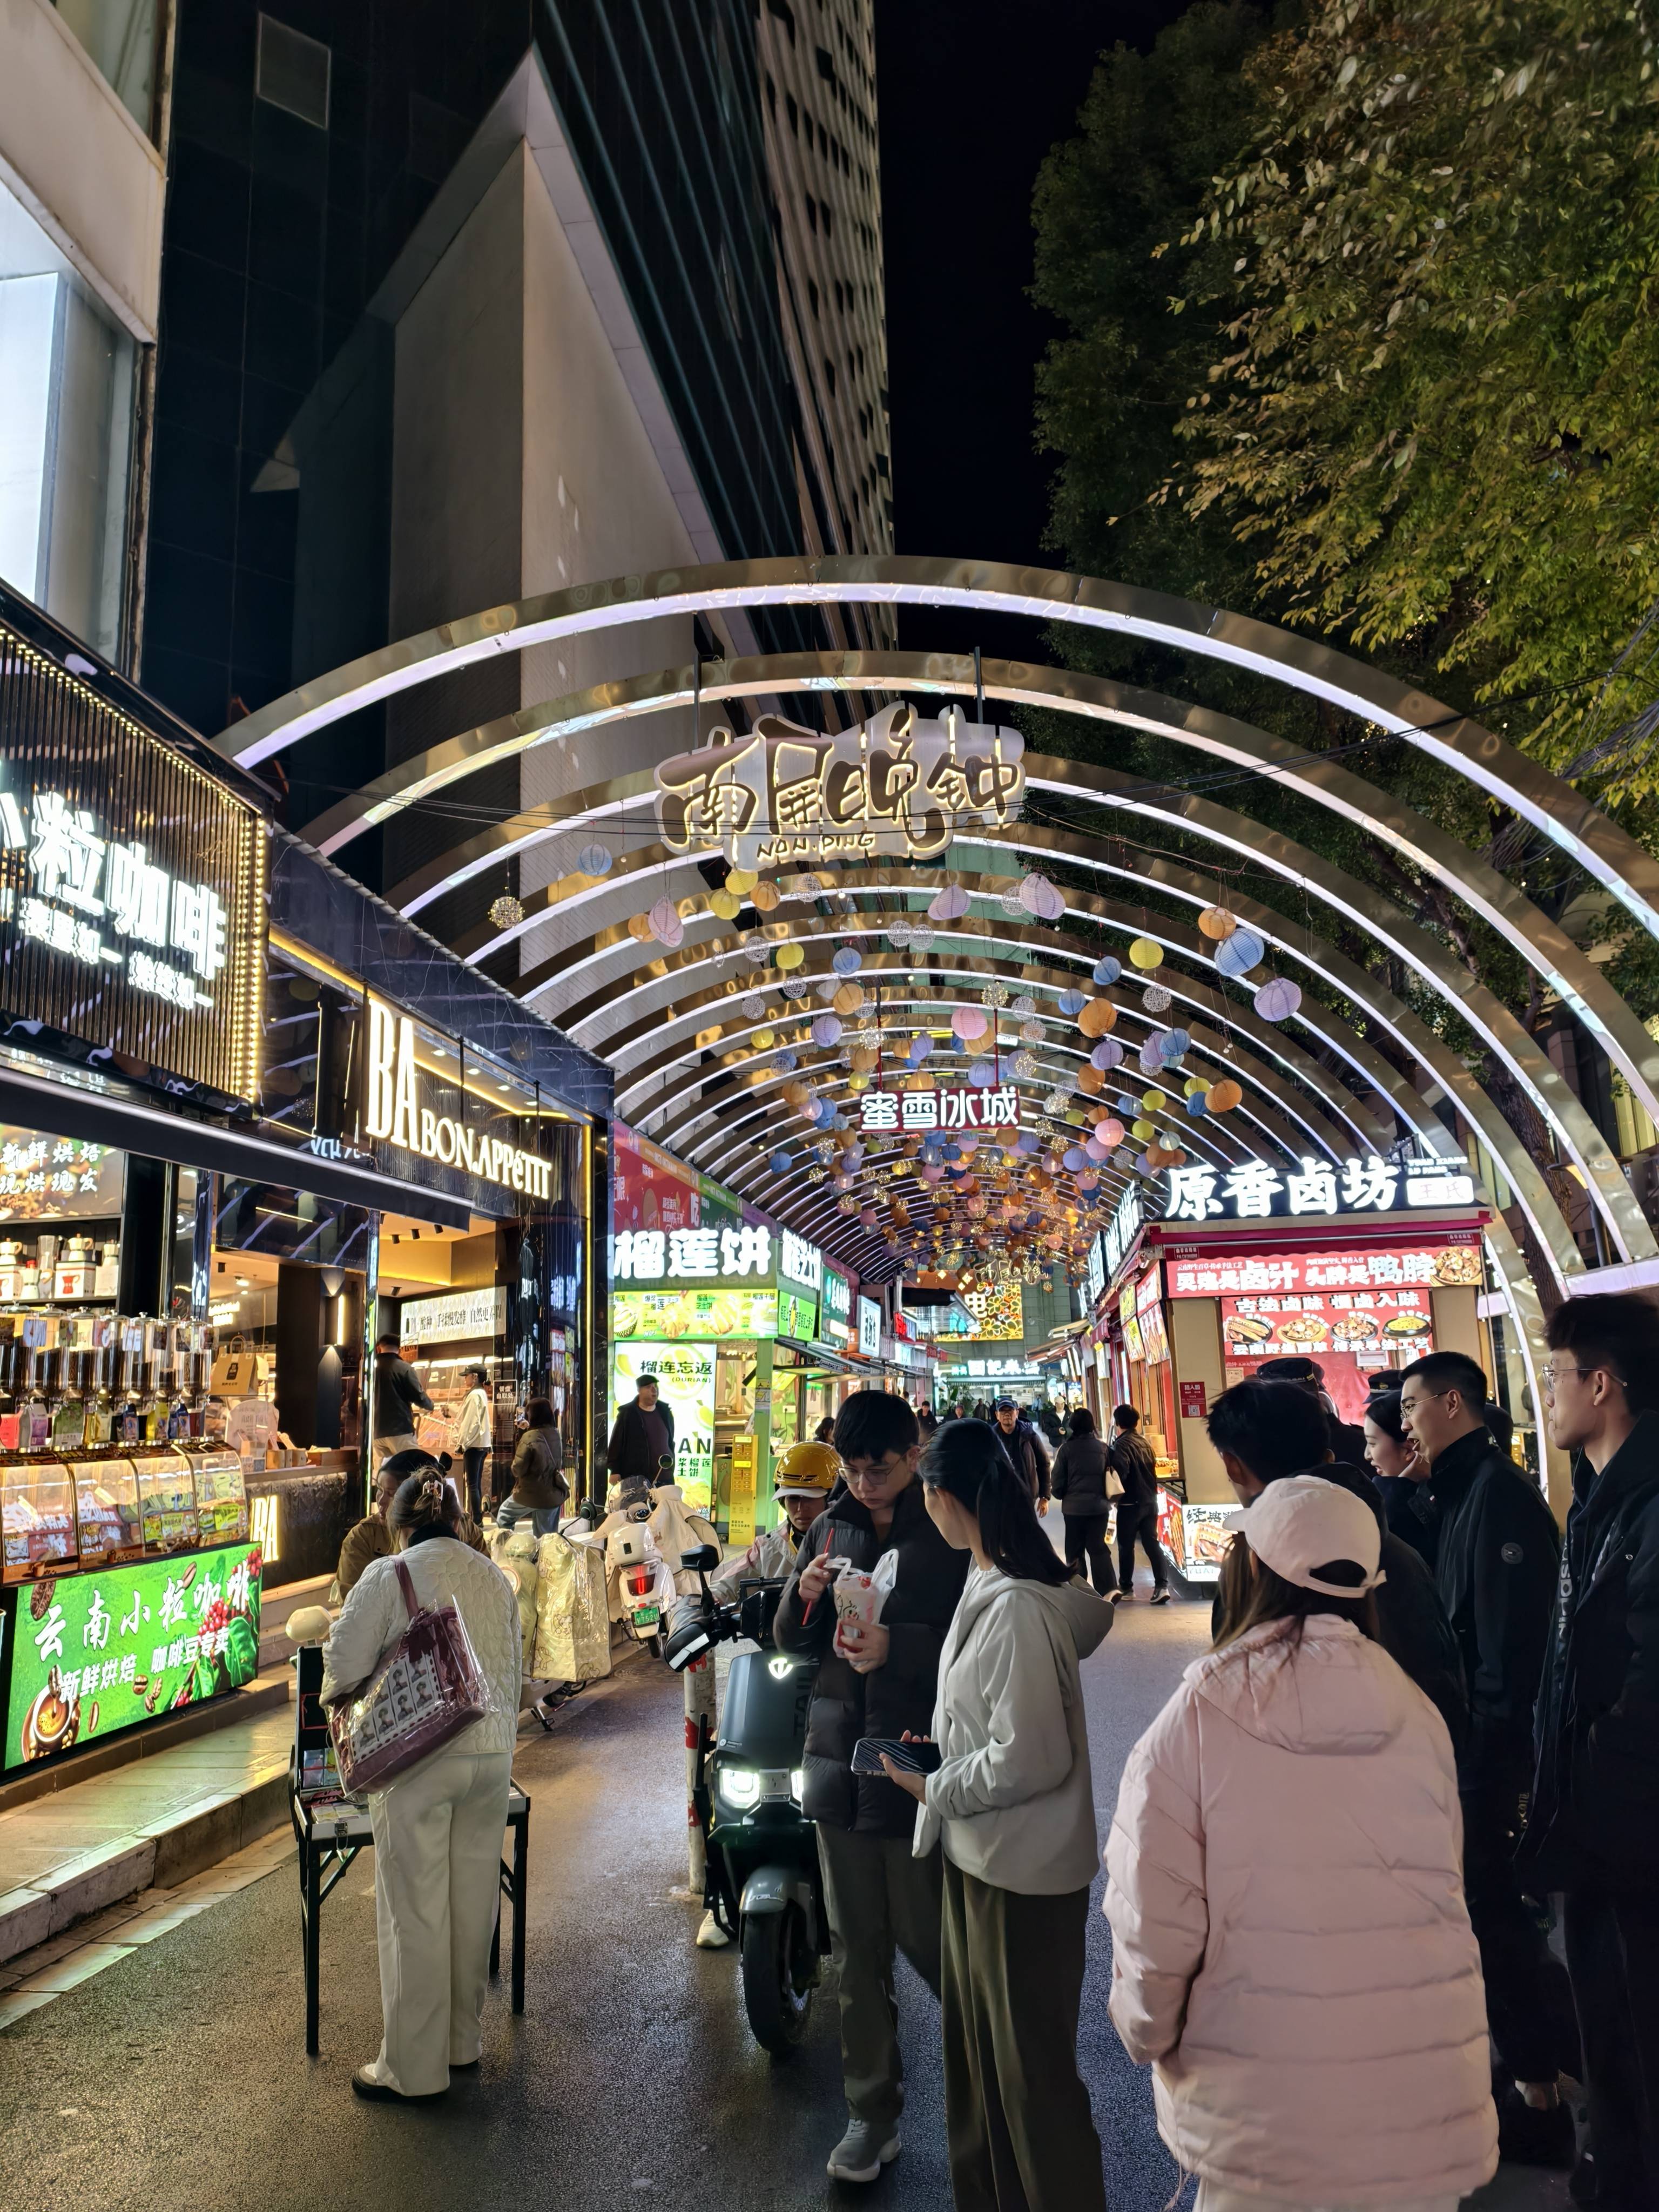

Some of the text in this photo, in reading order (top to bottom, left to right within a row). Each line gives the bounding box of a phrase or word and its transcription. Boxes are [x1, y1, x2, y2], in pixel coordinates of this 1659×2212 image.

[658, 705, 1021, 849] 南屏晚钟
[366, 997, 420, 1152] BA
[860, 1086, 1019, 1129] 蜜雪冰城
[1165, 1155, 1400, 1220] 原香卤坊
[1418, 1181, 1466, 1199] 王氏
[614, 1225, 771, 1279] 榴莲饼
[640, 1360, 713, 1374] 榴连忘返
[677, 1438, 711, 1454] AN
[678, 1458, 711, 1467] 浆榴莲
[678, 1468, 699, 1477] 士饼
[35, 1560, 250, 1662] 云南小粒咖啡
[59, 1626, 231, 1703] 新鲜烘焙 咖啡豆专卖
